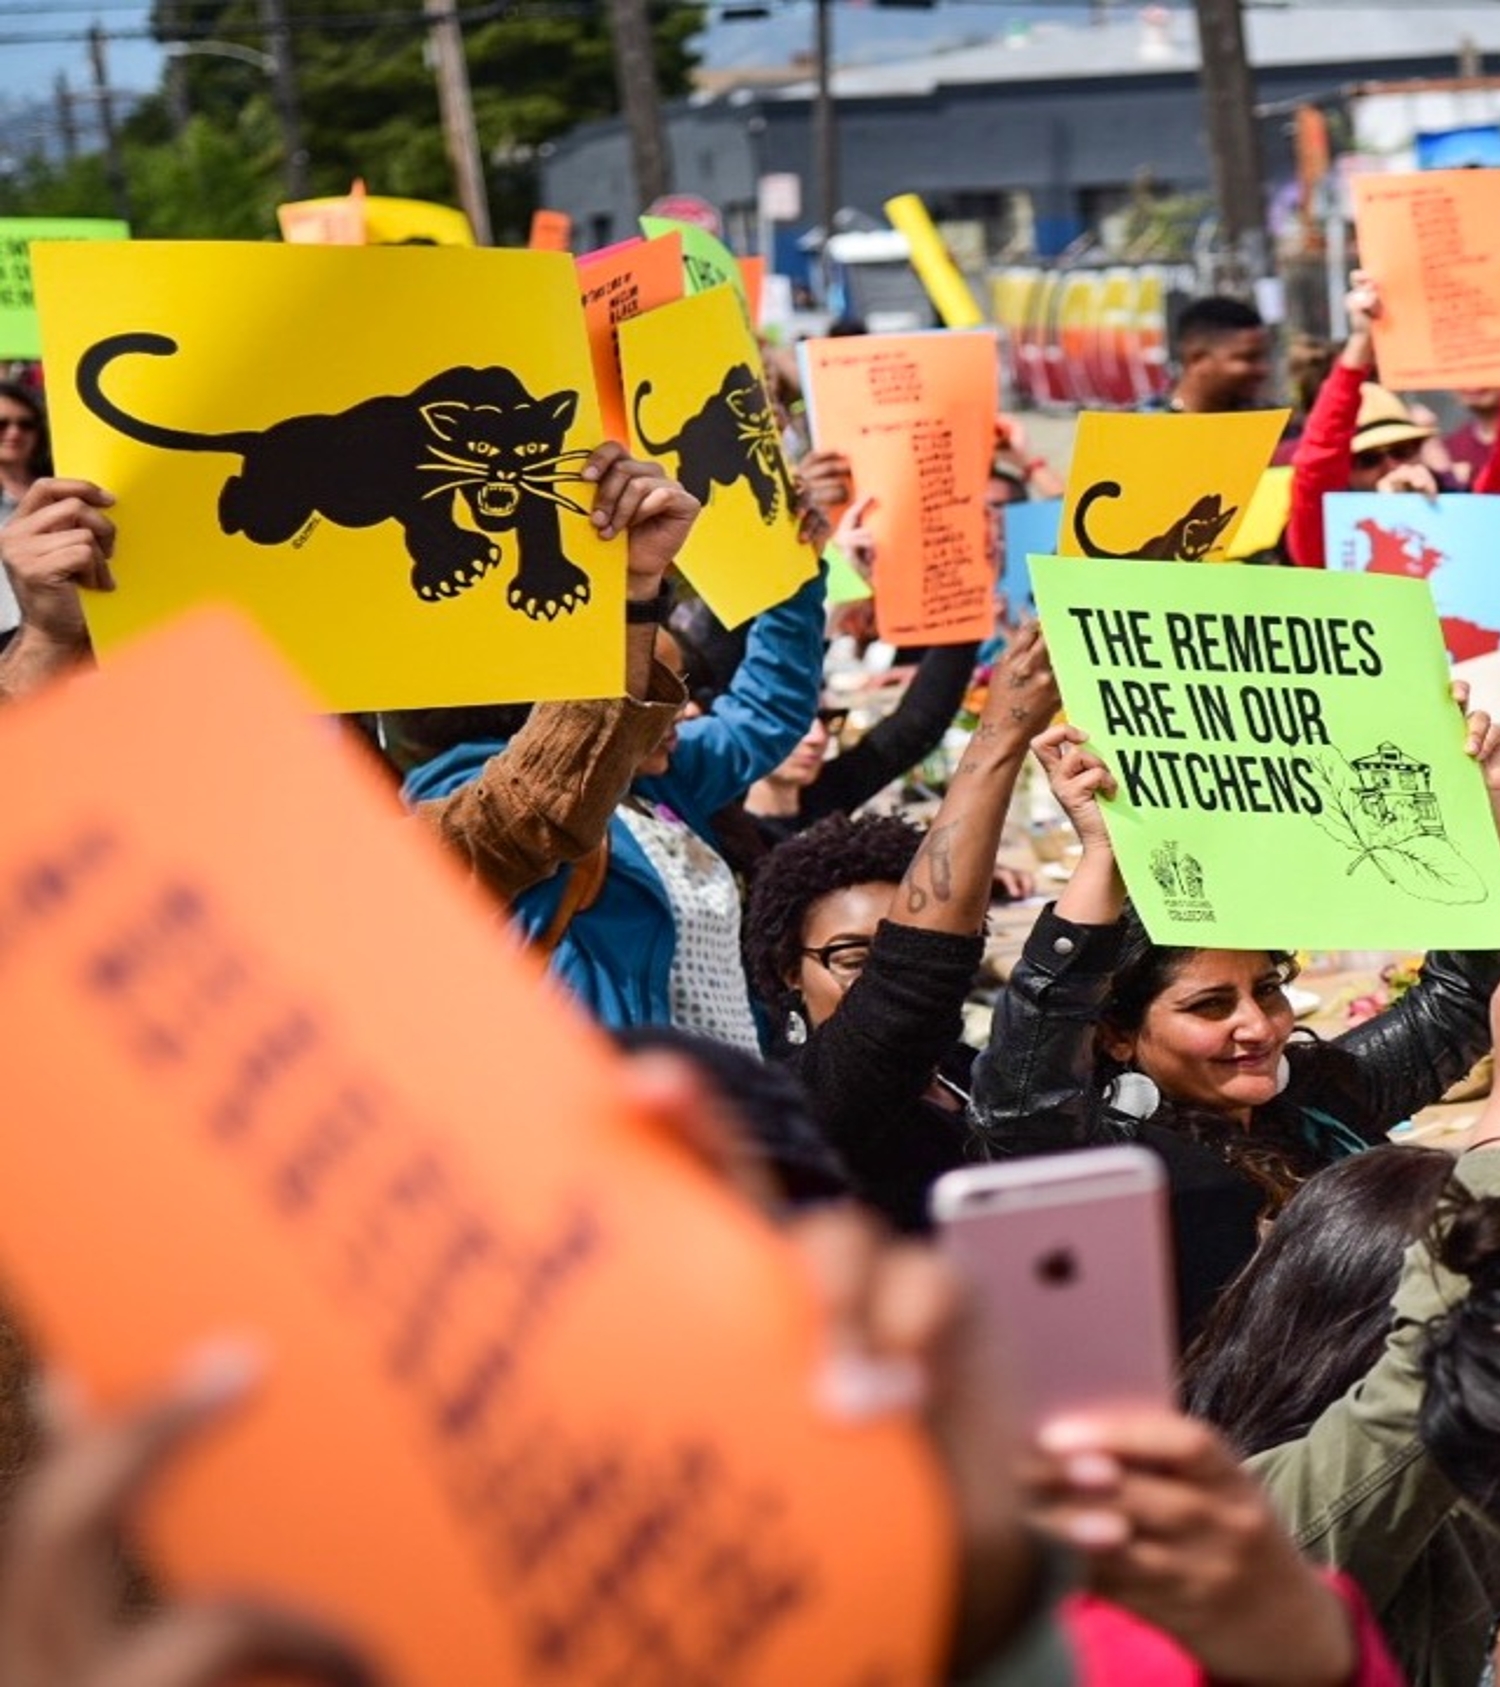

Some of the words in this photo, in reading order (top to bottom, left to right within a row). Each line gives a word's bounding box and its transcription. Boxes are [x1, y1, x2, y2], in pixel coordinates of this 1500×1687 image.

[1068, 607, 1162, 669] THE
[1165, 611, 1383, 677] REMEDIES
[1097, 679, 1187, 740] ARE
[1185, 683, 1237, 743] IN
[1241, 685, 1331, 747] OUR
[1117, 749, 1324, 816] KITCHENS
